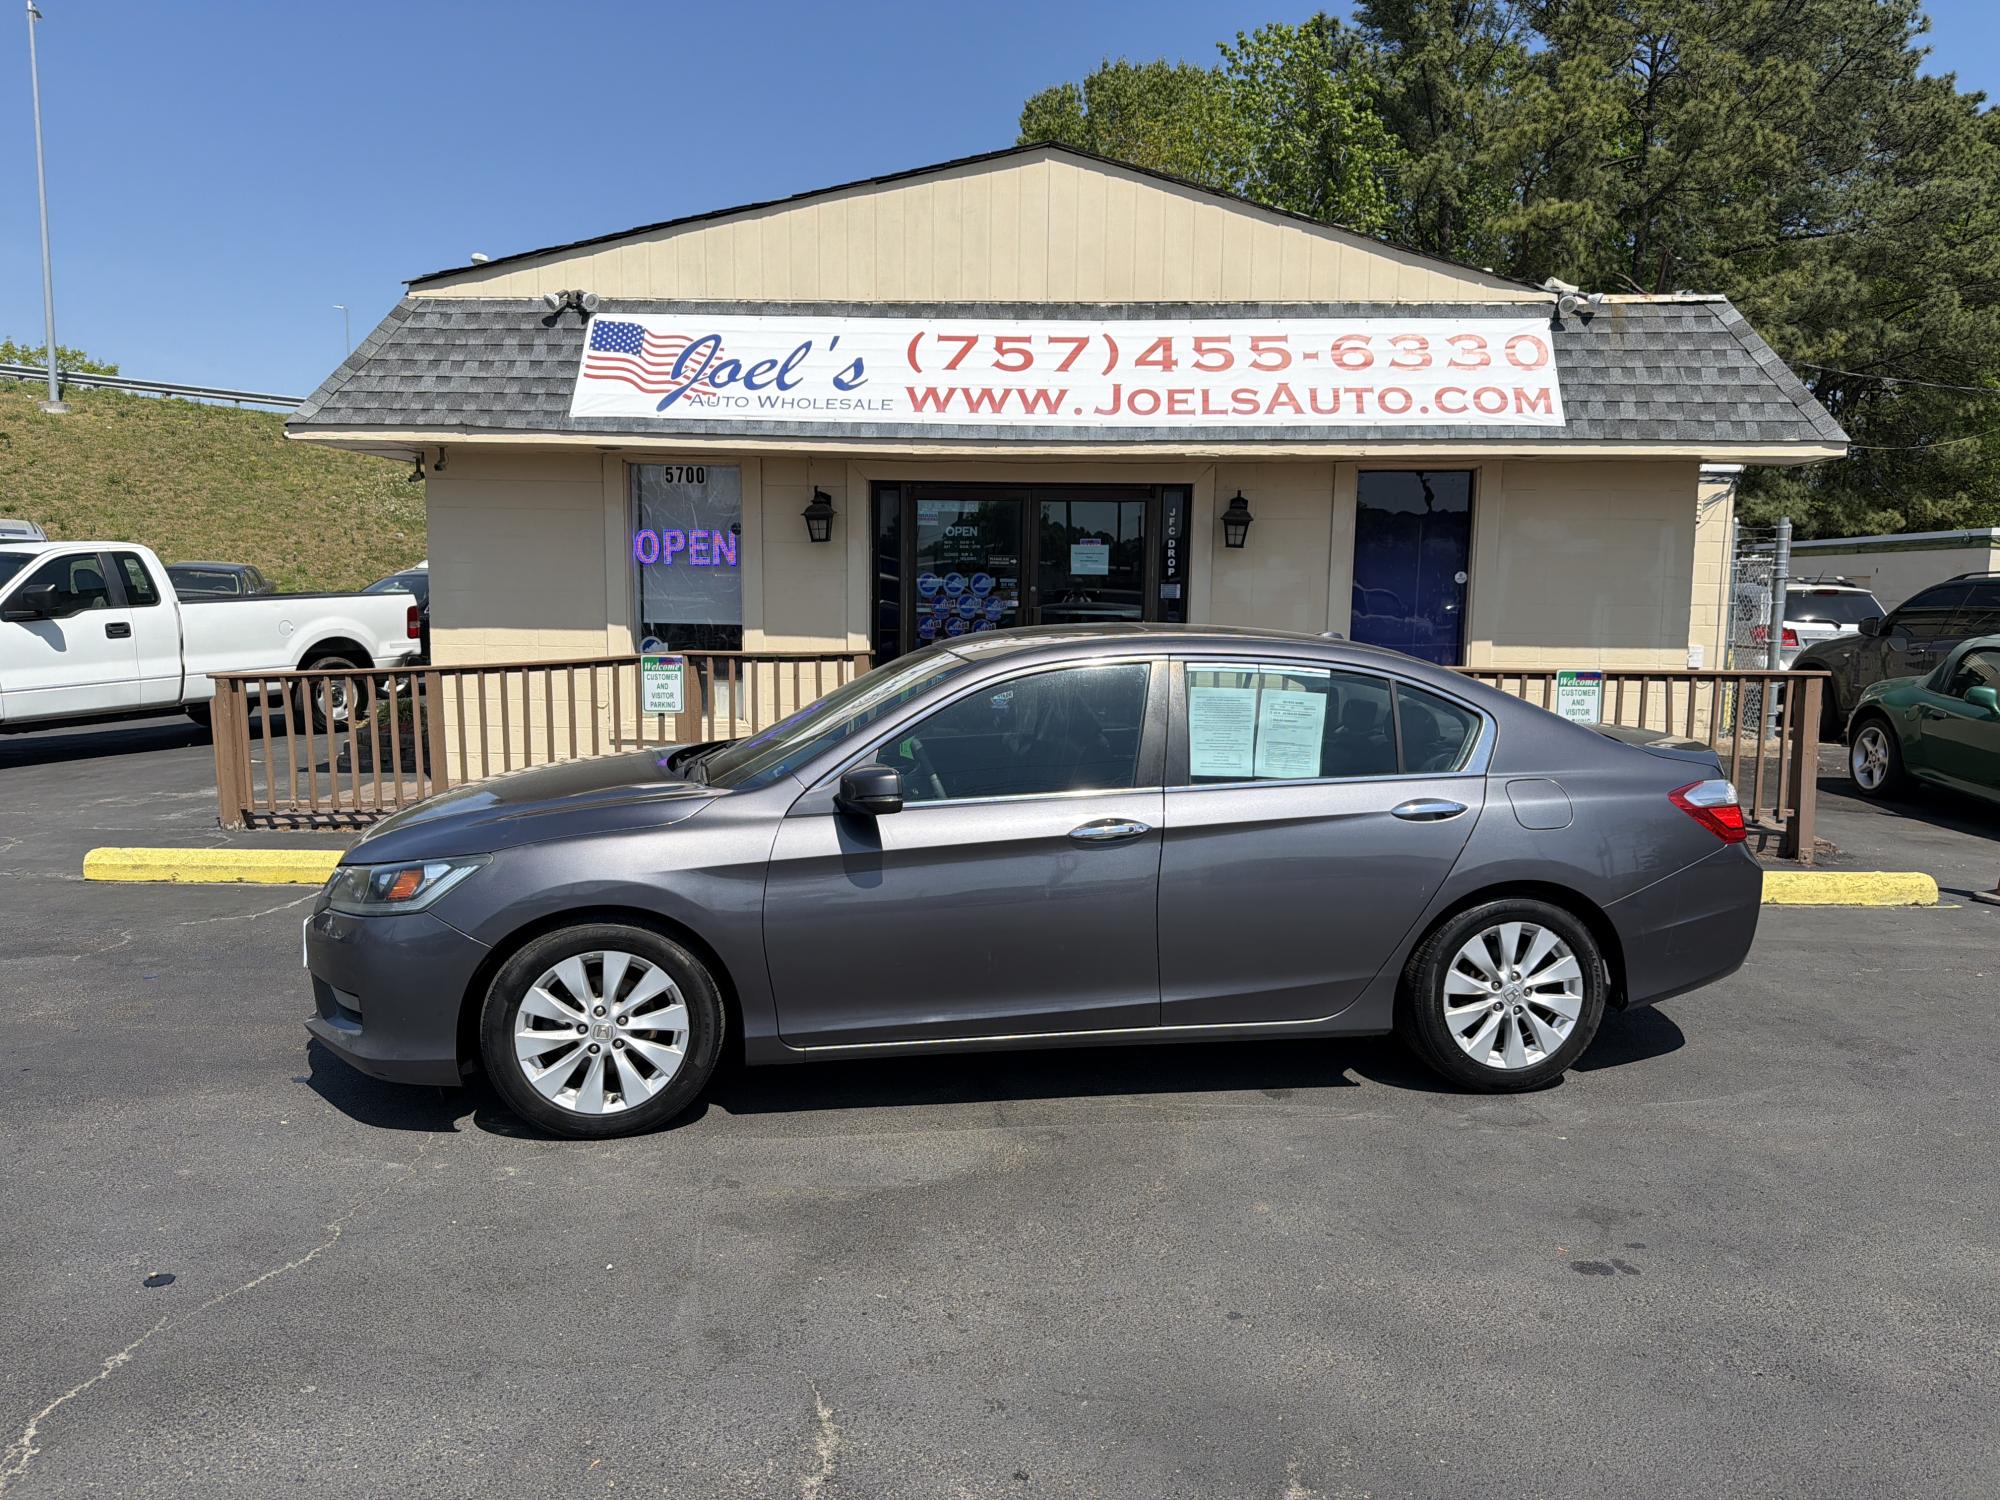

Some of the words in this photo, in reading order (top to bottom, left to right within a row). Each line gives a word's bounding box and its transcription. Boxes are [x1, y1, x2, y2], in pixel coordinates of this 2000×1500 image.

[907, 331, 1549, 376] (757)455-6330
[656, 334, 869, 412] Joel's
[689, 393, 750, 409] AUTO
[758, 394, 894, 412] WHOLESALE
[665, 466, 705, 484] 5700
[1168, 507, 1176, 536] JFC
[945, 526, 978, 537] OPEN
[635, 528, 737, 567] OPEN
[1167, 538, 1176, 577] DROP
[643, 661, 681, 672] Welcome
[646, 673, 679, 681] CUSTOMER
[1560, 677, 1599, 687] Welcome
[656, 682, 669, 690] AND
[1561, 689, 1596, 697] CUSTOMER
[650, 701, 676, 709] PARKING
[1571, 698, 1585, 706] AND
[1565, 708, 1590, 716] VISITOR
